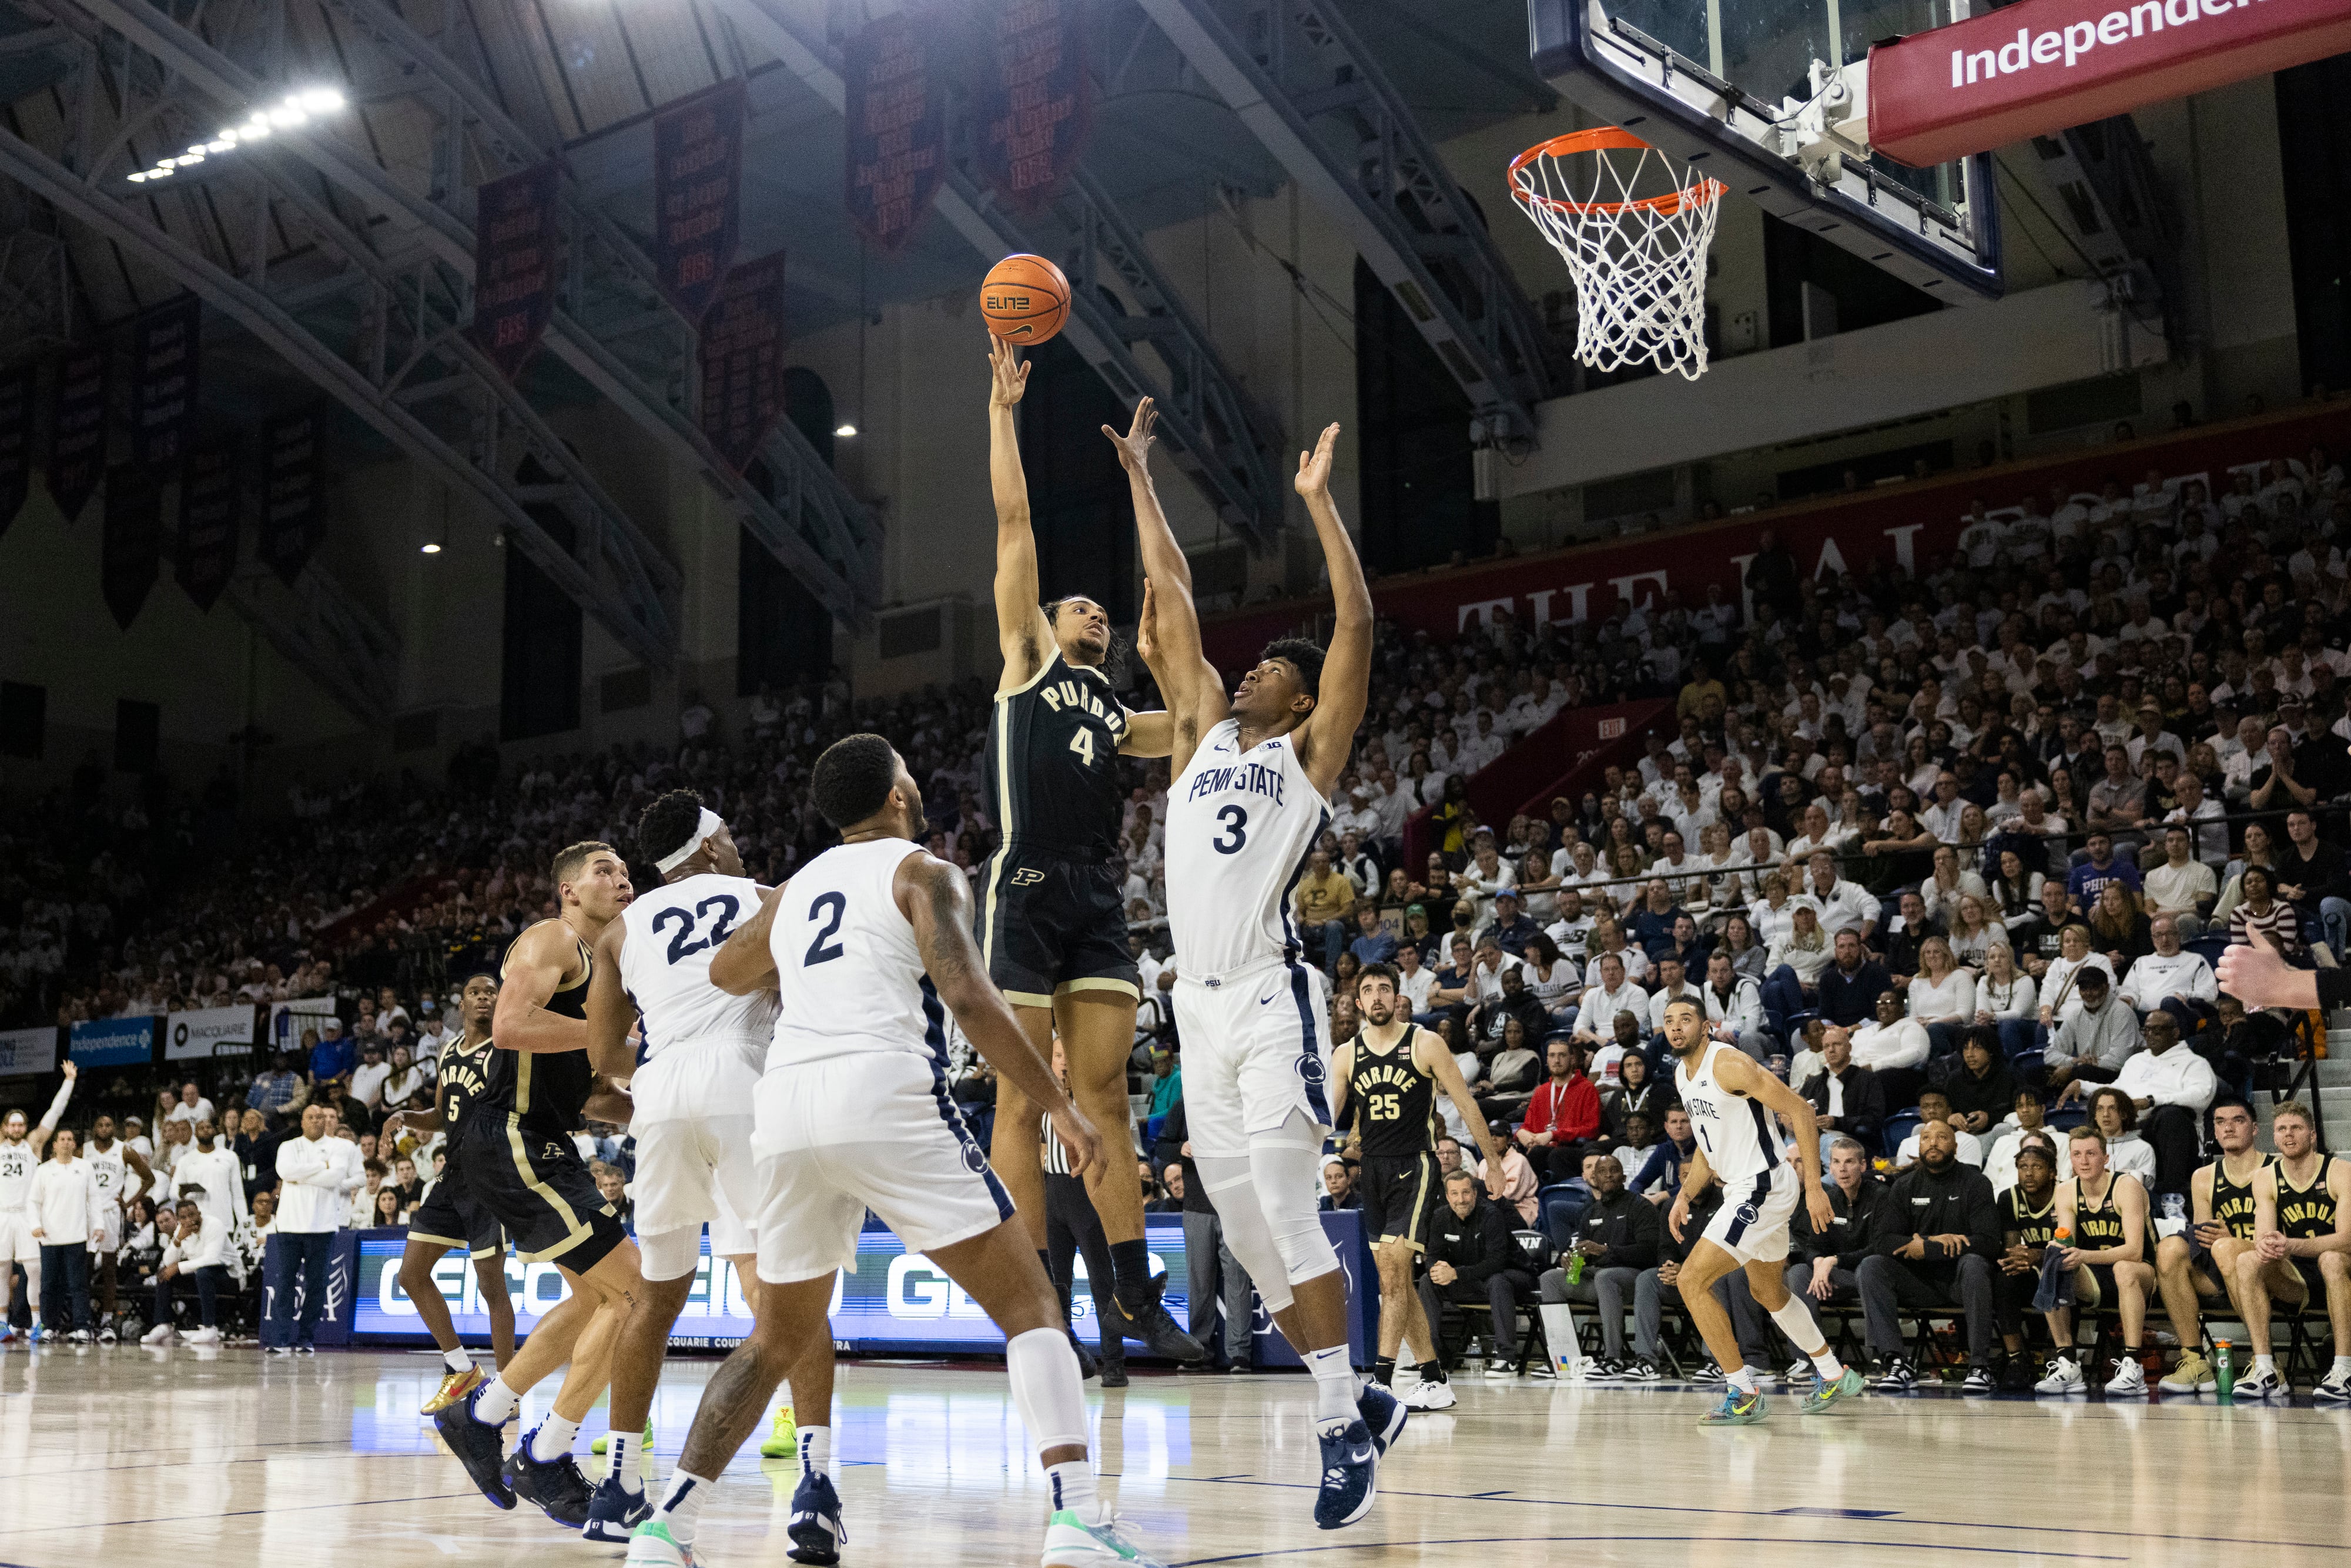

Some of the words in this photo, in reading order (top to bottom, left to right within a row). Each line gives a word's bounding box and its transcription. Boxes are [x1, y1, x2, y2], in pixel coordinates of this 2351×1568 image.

[987, 296, 1030, 311] ELITE
[1070, 726, 1094, 766] 4
[1188, 766, 1238, 803] PENN
[1235, 763, 1284, 808] STATE
[1213, 804, 1248, 855] 3
[1011, 867, 1045, 886] P
[652, 894, 740, 966] 22
[804, 891, 846, 967] 2
[1379, 917, 1399, 931] 04
[1205, 979, 1221, 987] PSU
[441, 1065, 485, 1097] URDUE
[1354, 1064, 1417, 1097] PURDUE
[448, 1095, 460, 1122] 5
[1369, 1094, 1400, 1120] 25
[1692, 1098, 1721, 1120] STATE
[1700, 1124, 1713, 1153] 1
[3, 1162, 22, 1176] 24
[2215, 1196, 2256, 1224] PURD
[2081, 1219, 2125, 1238] URDU
[668, 1336, 709, 1348] CQUARIE
[592, 1521, 600, 1529] 07
[805, 1512, 815, 1520] 07
